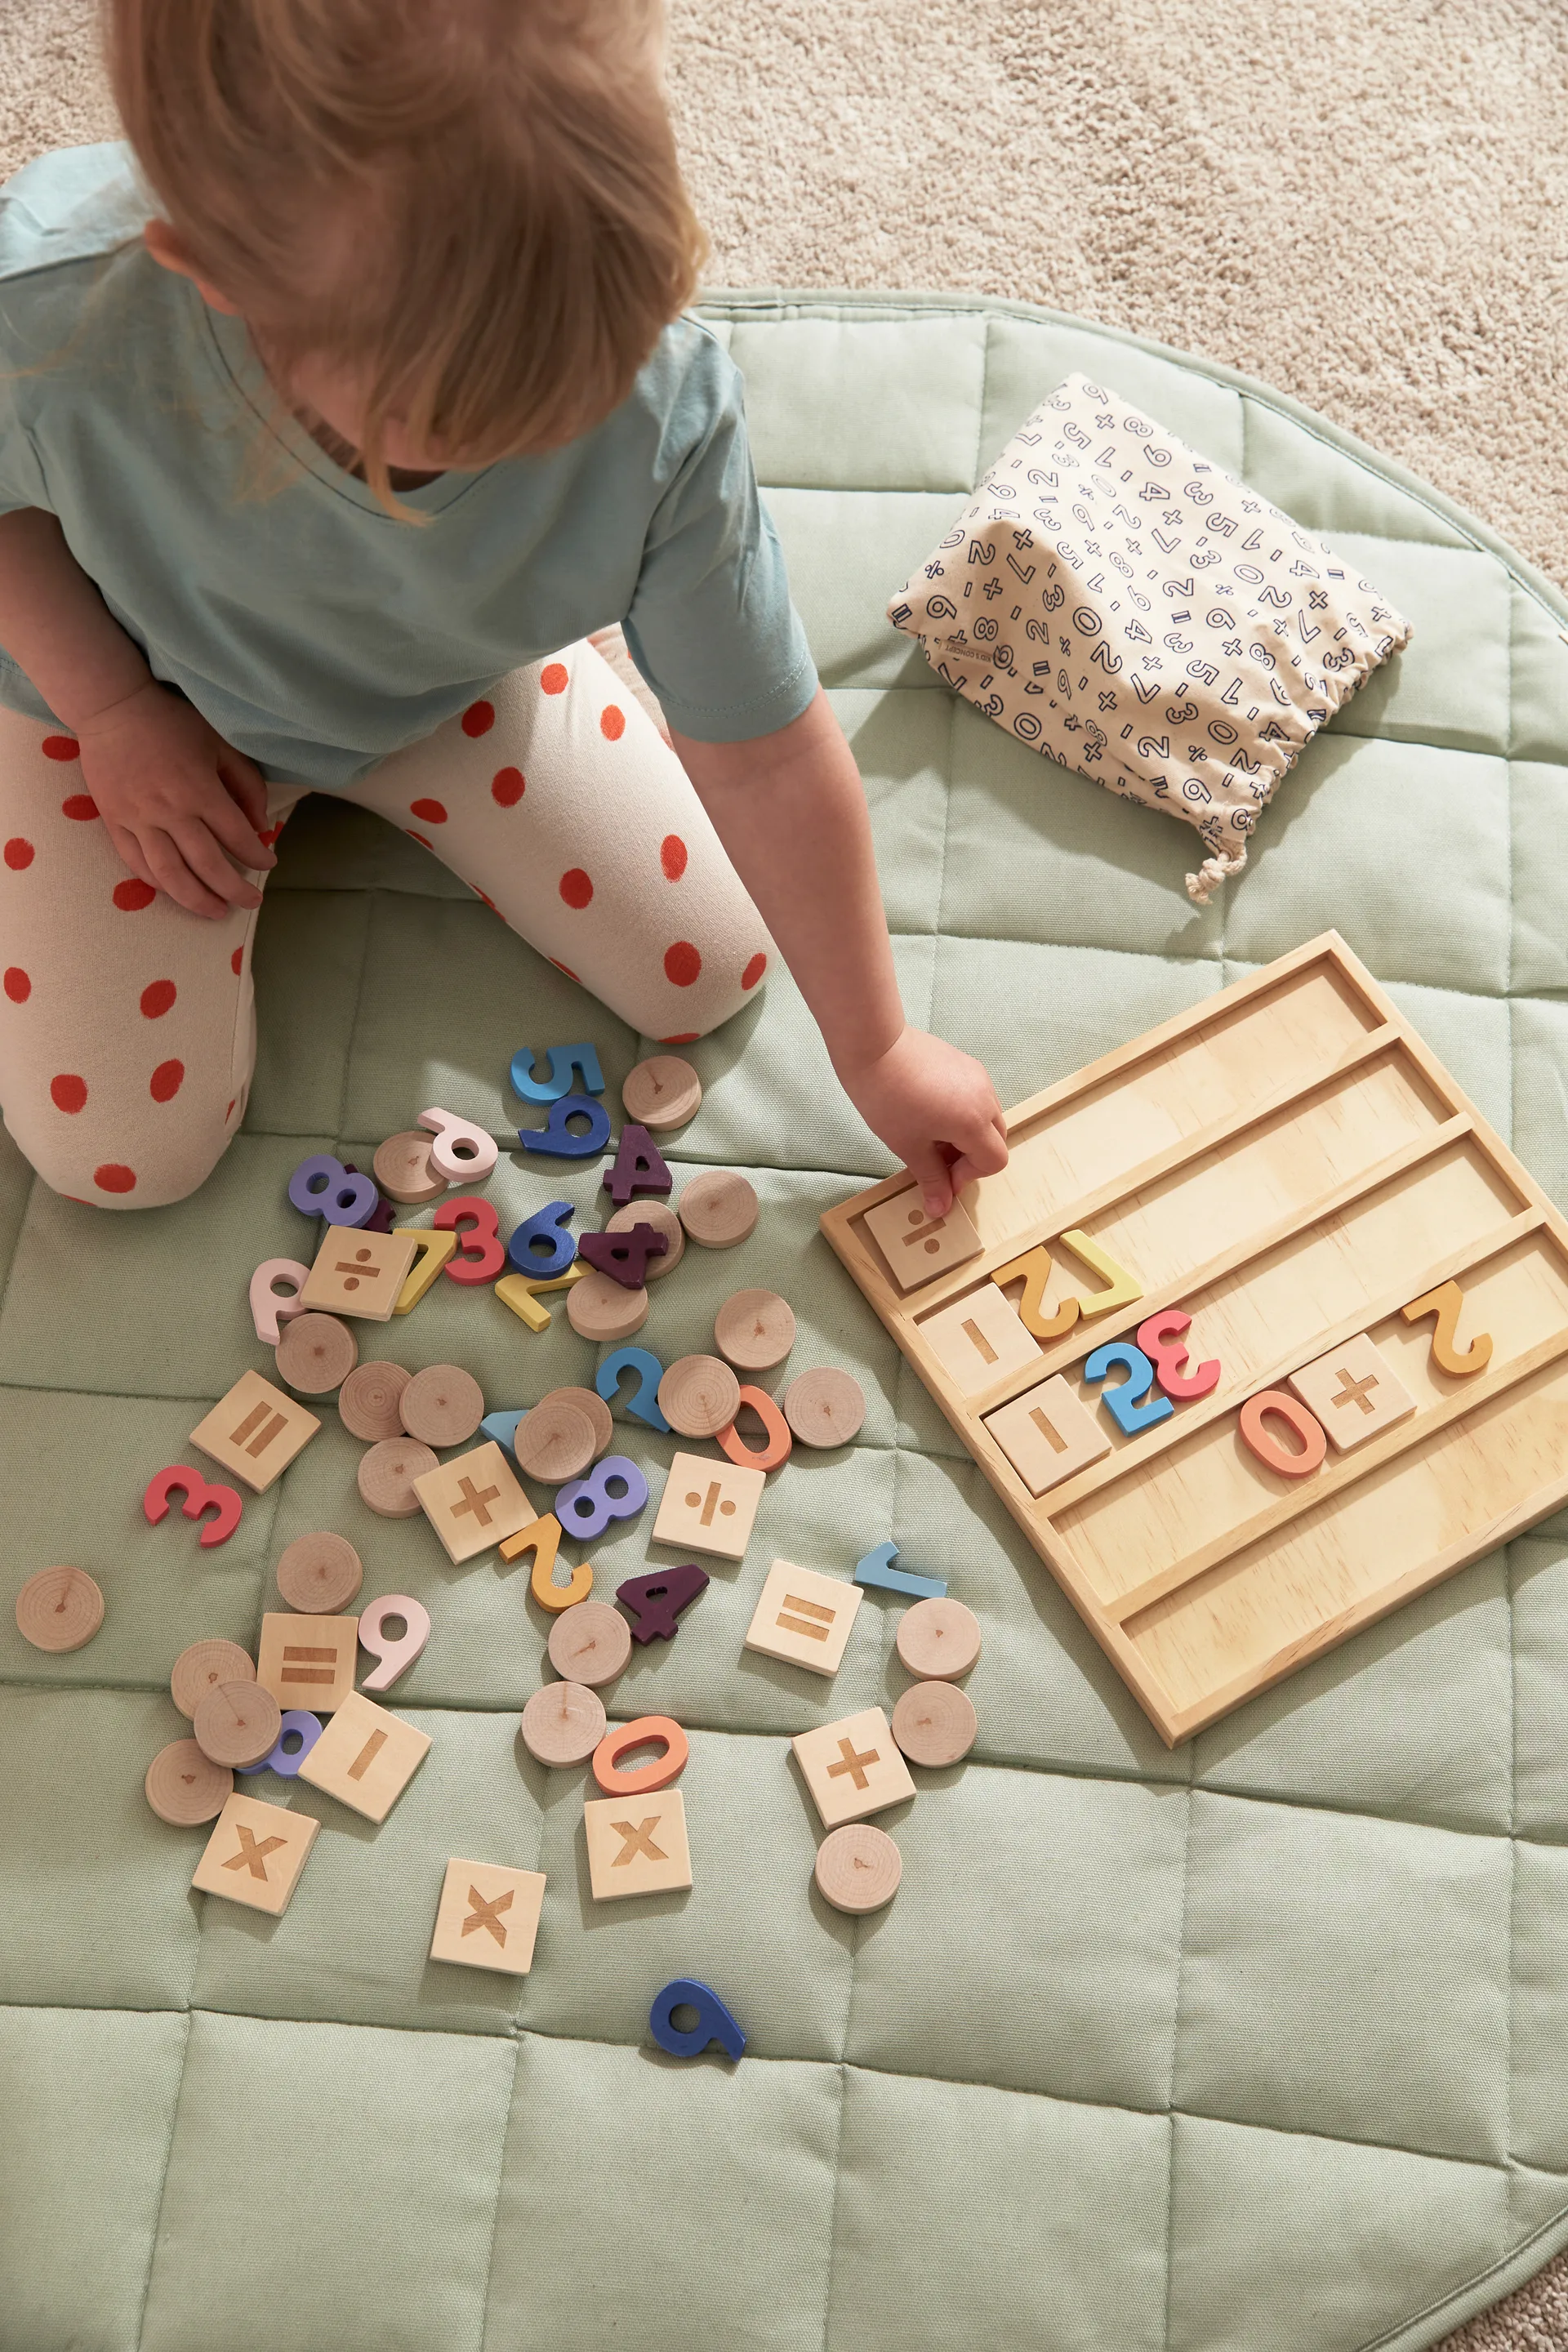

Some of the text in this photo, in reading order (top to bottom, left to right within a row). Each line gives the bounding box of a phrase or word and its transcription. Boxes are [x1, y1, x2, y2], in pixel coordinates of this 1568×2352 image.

[1124, 416, 1153, 438] 8
[1109, 552, 1134, 578] 8
[945, 644, 975, 658] CONCEPT
[973, 616, 999, 641] 8
[1250, 643, 1276, 670] 8
[510, 1043, 606, 1106] 5
[289, 1155, 378, 1227] 8
[603, 1125, 672, 1205] 4
[434, 1196, 505, 1285] 3
[509, 1201, 575, 1280] 6
[578, 1223, 669, 1289] 4
[991, 1245, 1080, 1343] 2
[1136, 1309, 1222, 1403] 3
[1238, 1390, 1327, 1480] 0
[1400, 1280, 1494, 1379] 2
[144, 1465, 242, 1548] 3
[555, 1455, 648, 1541] 8
[499, 1513, 594, 1615] 2
[358, 1594, 430, 1691] 9
[617, 1563, 710, 1646] 4
[593, 1715, 689, 1796] 0
